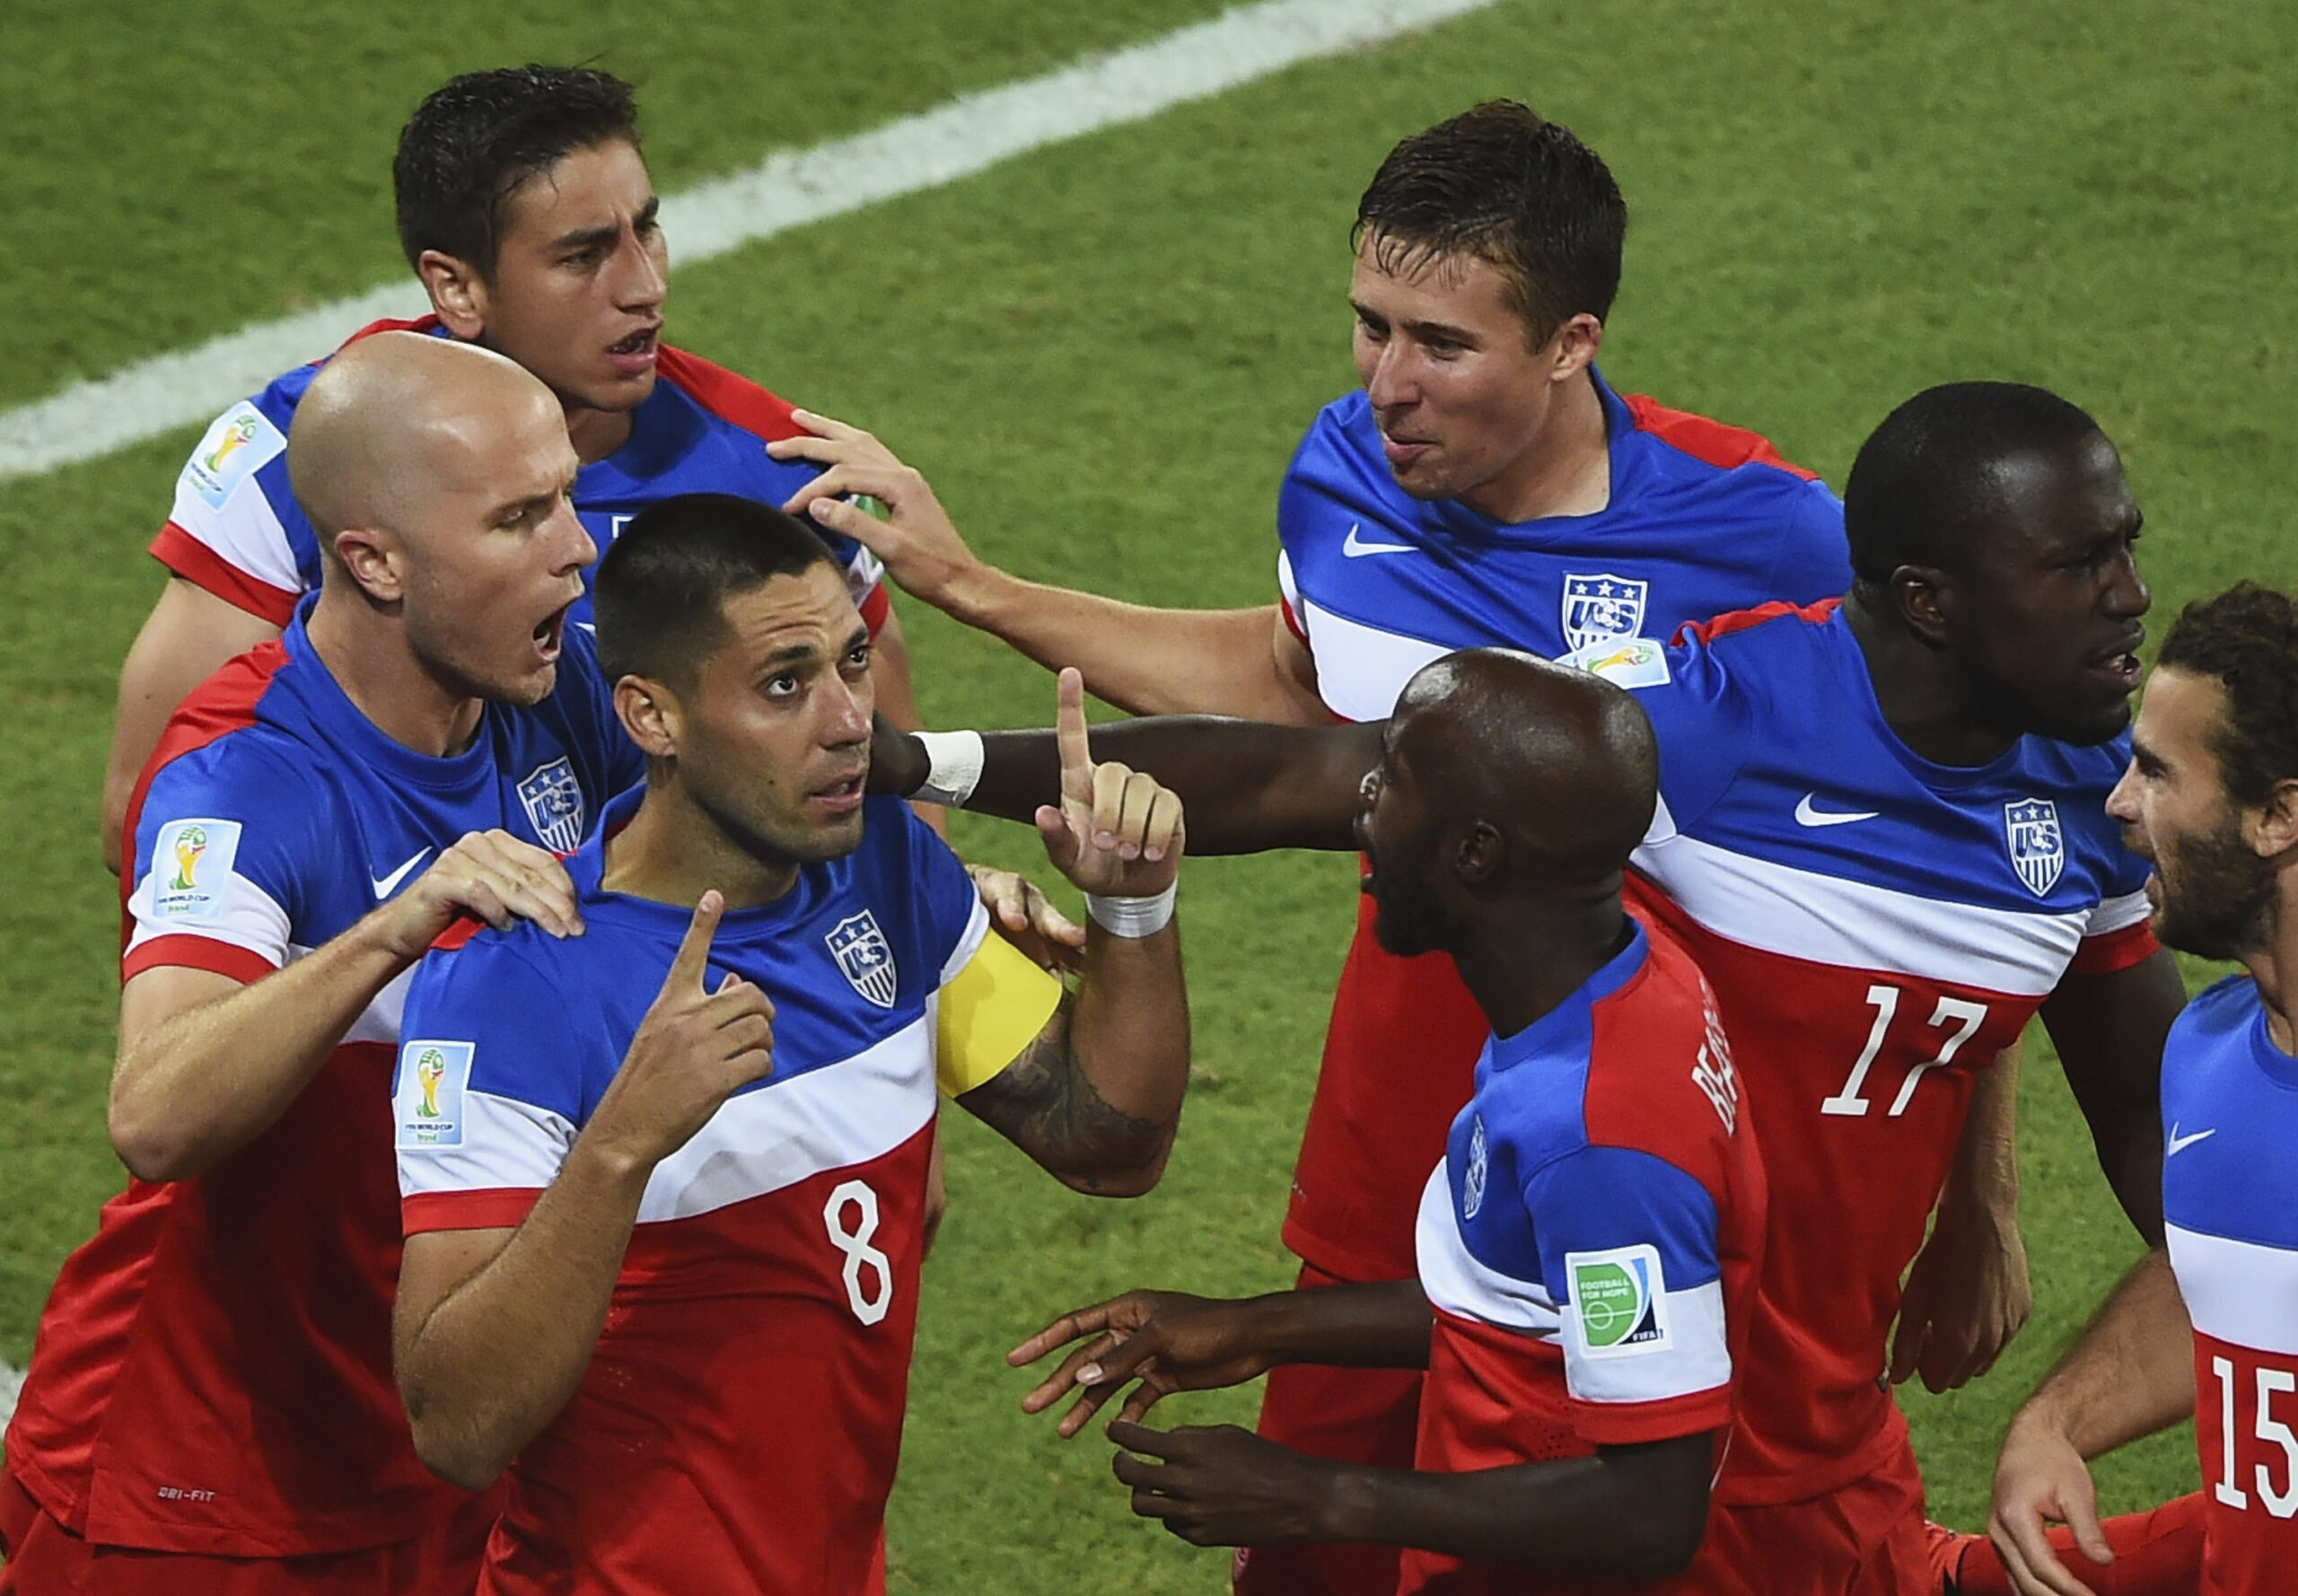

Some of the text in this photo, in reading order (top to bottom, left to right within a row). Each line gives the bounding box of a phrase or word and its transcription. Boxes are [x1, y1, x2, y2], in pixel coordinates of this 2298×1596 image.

[1820, 985, 1988, 1117] 17
[823, 1179, 893, 1327] 8
[1580, 1276, 1631, 1291] FOOTBALL
[1581, 1287, 1629, 1301] FOR HOPE
[1632, 1330, 1658, 1342] FIFA
[2213, 1355, 2298, 1519] 15
[157, 1486, 215, 1502] DRI-FIT
